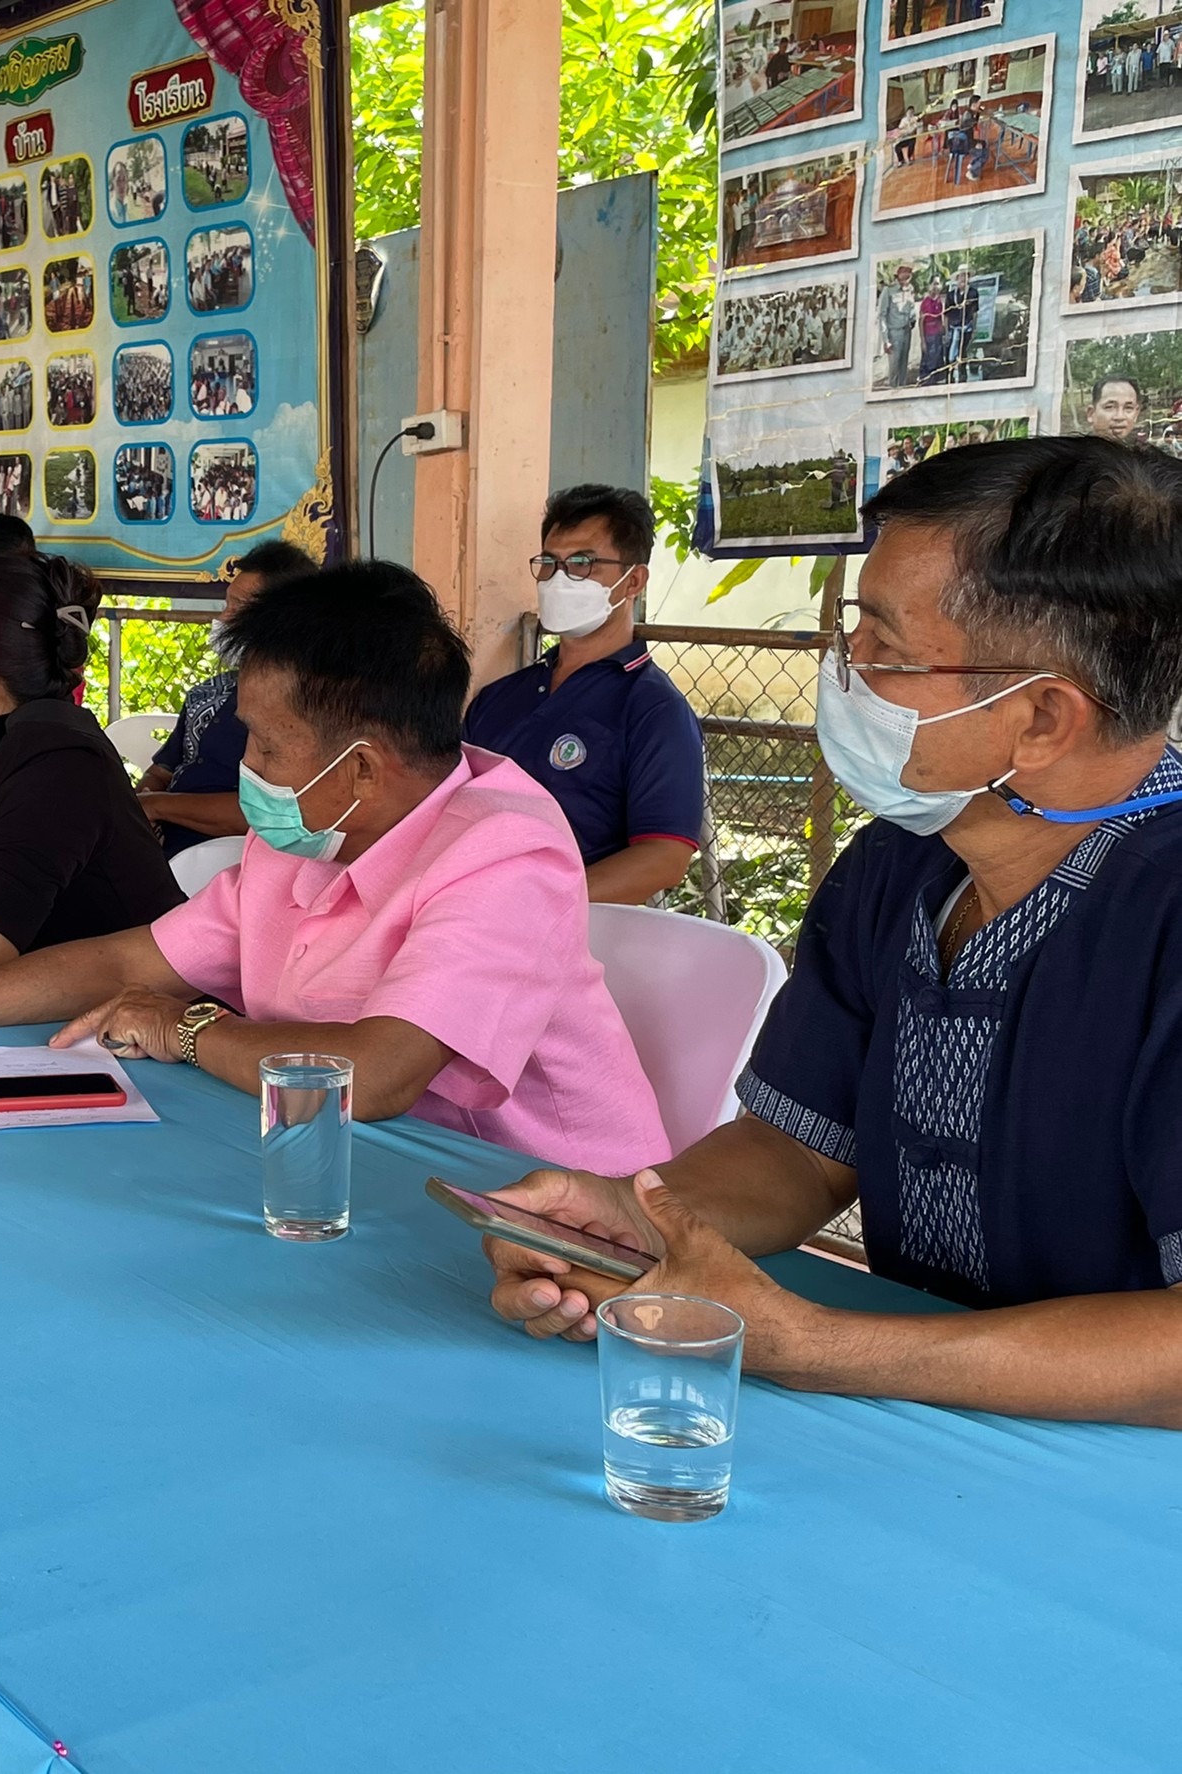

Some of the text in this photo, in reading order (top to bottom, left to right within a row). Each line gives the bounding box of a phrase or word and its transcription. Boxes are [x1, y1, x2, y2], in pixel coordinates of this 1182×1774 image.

[134, 74, 207, 123] โรงเรียน
[12, 121, 47, 161] บ้าน
